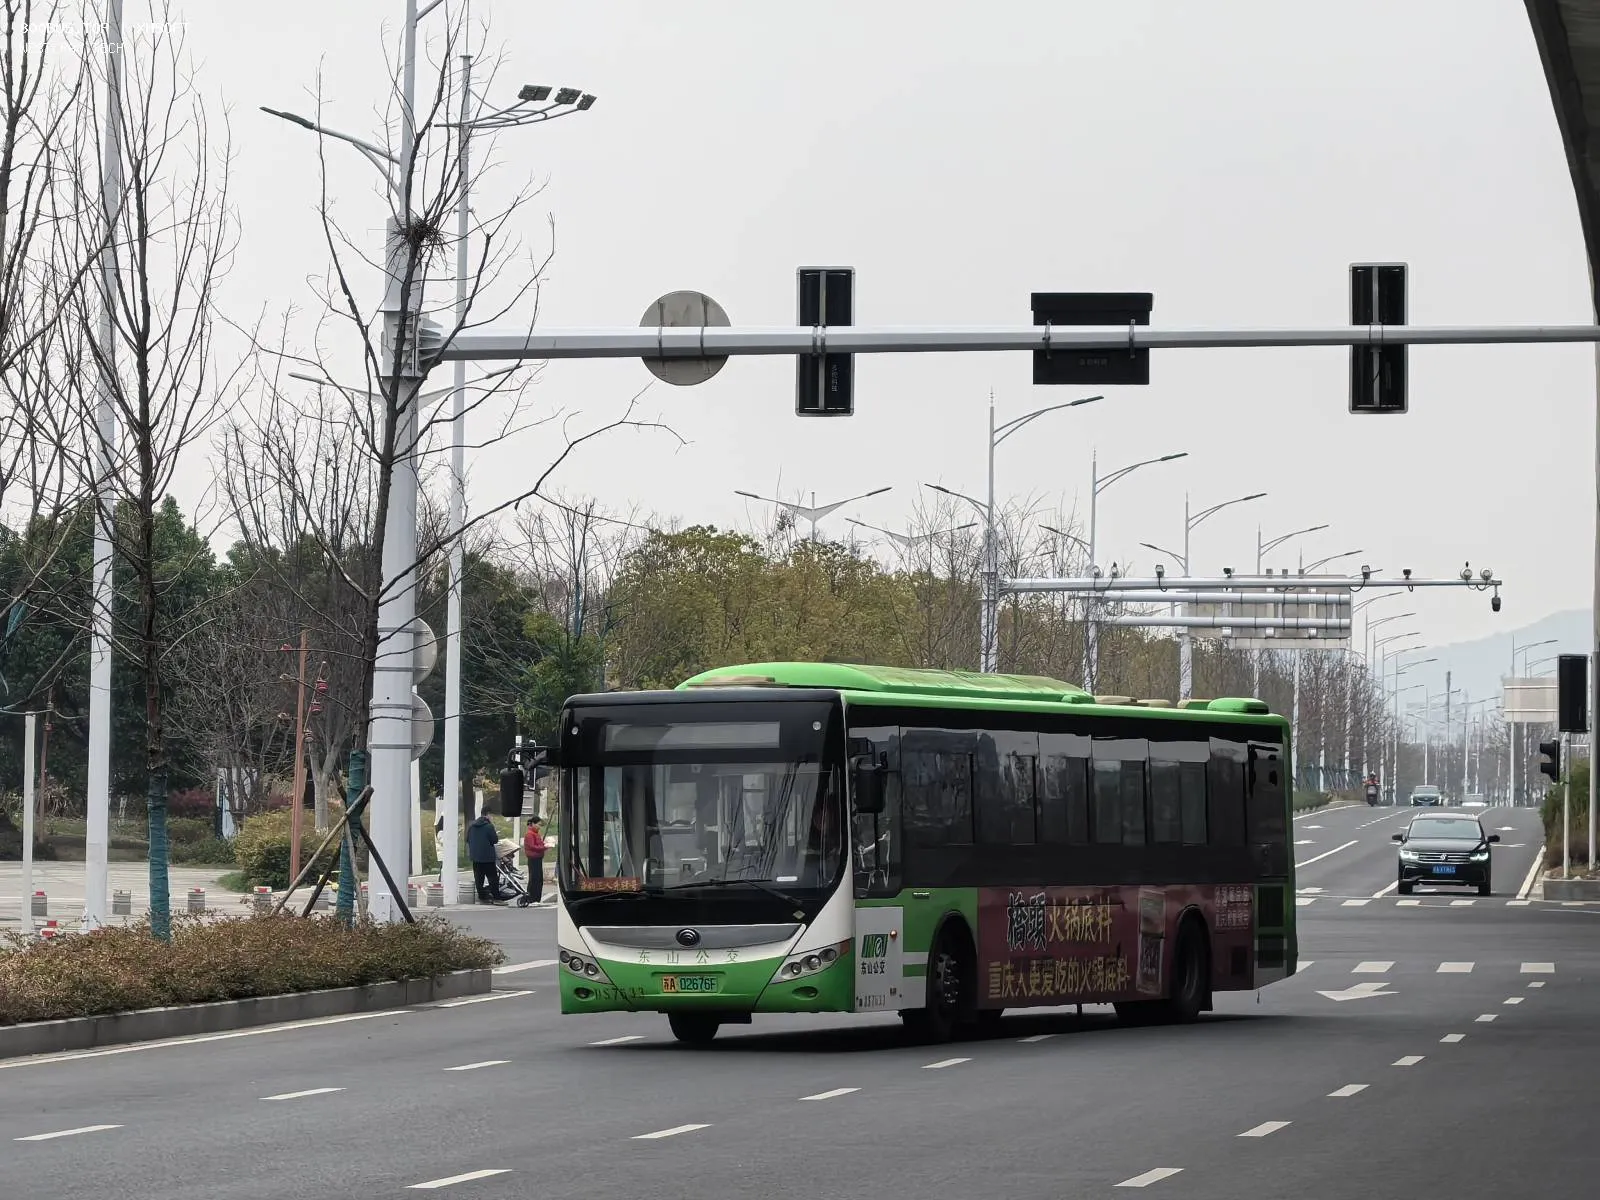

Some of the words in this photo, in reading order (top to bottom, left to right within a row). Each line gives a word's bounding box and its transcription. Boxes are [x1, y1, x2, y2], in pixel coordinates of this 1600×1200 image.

[638, 949, 739, 965] 东山公交
[861, 961, 886, 975] 东山公交
[988, 956, 1130, 998] 重庆人更爱吃的火锅底料
